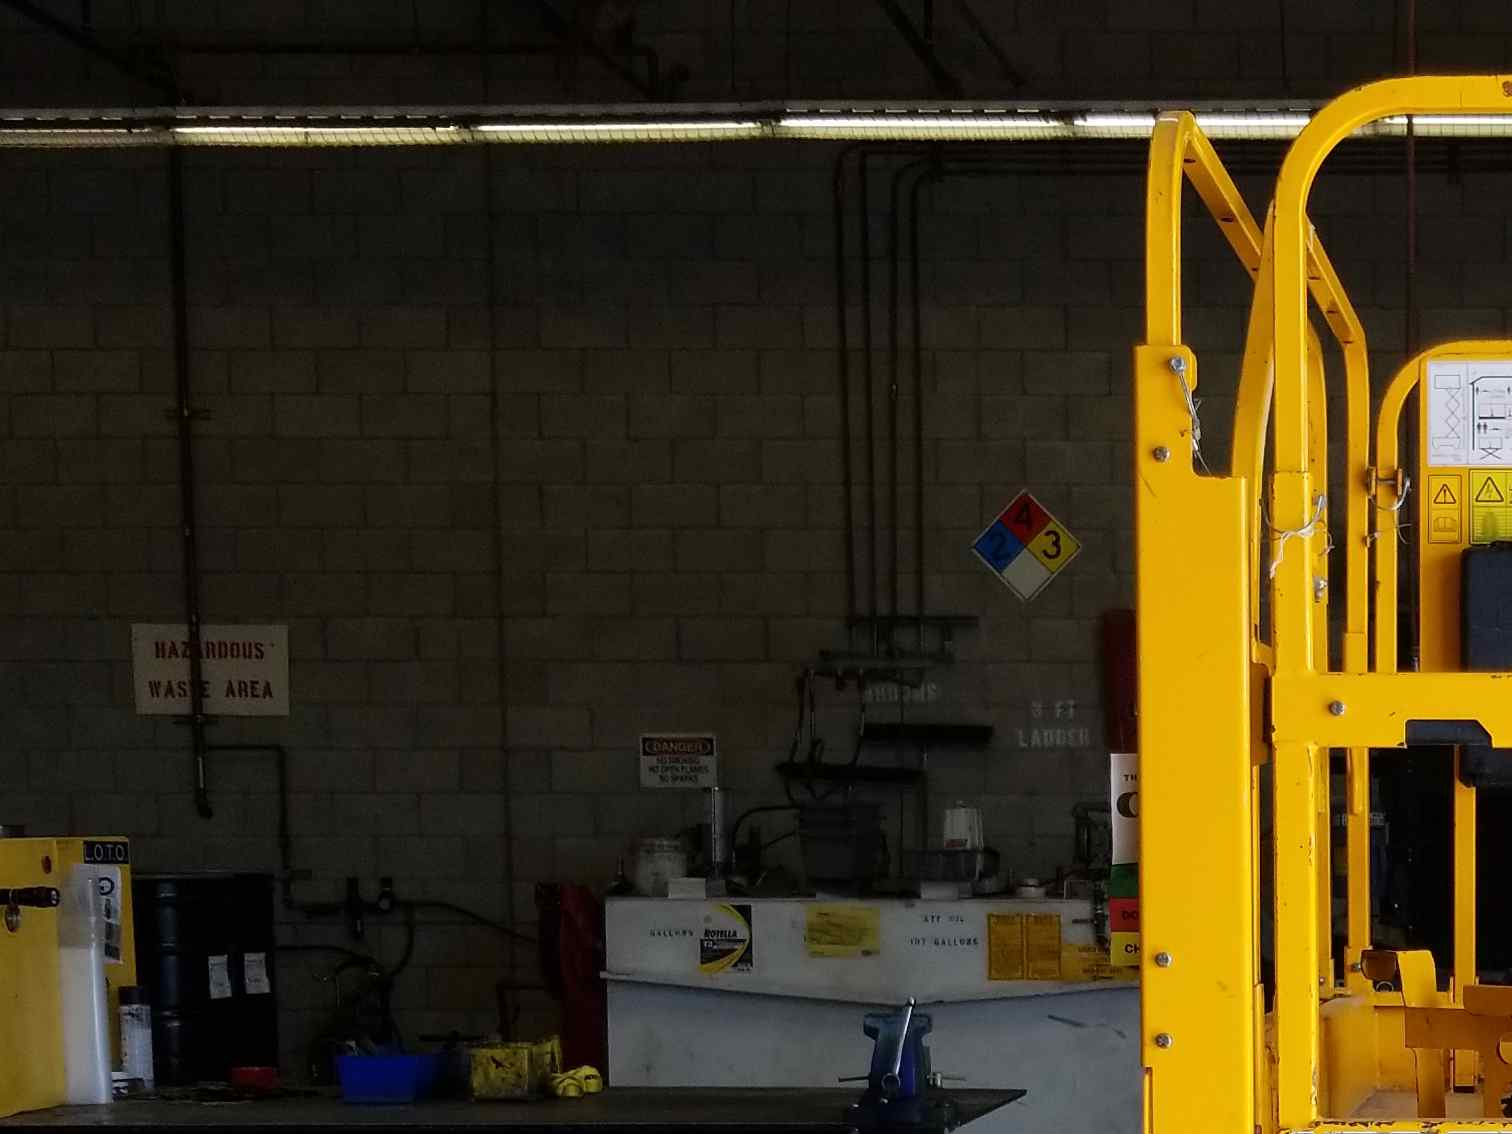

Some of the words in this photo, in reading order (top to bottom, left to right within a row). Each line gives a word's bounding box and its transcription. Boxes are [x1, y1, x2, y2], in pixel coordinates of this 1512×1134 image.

[990, 530, 1011, 561] 2
[1042, 530, 1061, 559] 3
[154, 640, 265, 660] HAZRDOUS
[149, 679, 211, 698] WASE
[225, 679, 274, 698] AREA
[653, 741, 704, 753] DANGER
[1017, 727, 1091, 748] LADDER
[704, 929, 737, 938] ROTELLA
